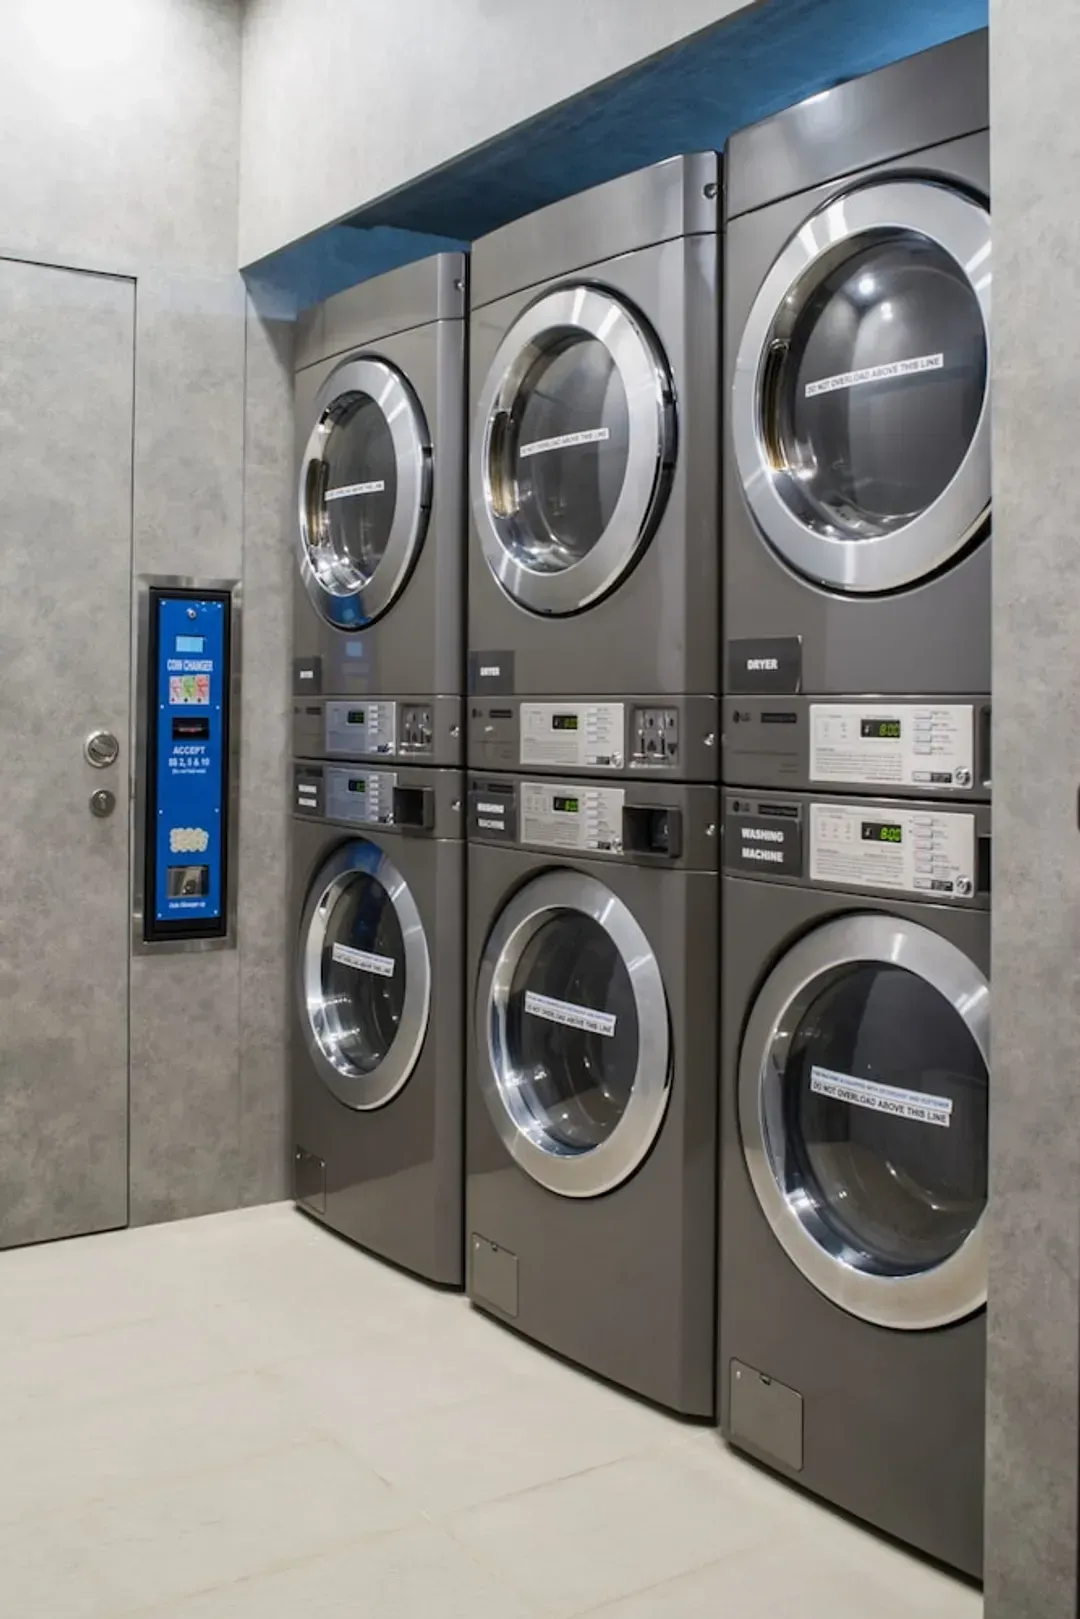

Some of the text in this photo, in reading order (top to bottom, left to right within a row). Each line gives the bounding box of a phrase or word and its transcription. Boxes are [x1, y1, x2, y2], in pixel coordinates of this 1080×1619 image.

[808, 357, 940, 394] DO NOT OVERLOAD ABOVE THIS LINE
[747, 659, 778, 670] DRYER
[173, 746, 206, 755] ACCEPT
[741, 828, 784, 843] WASHING
[742, 847, 784, 862] MACHINE
[813, 1080, 947, 1124] DO NOT OVERLOAD ABOVE THIS LINE
